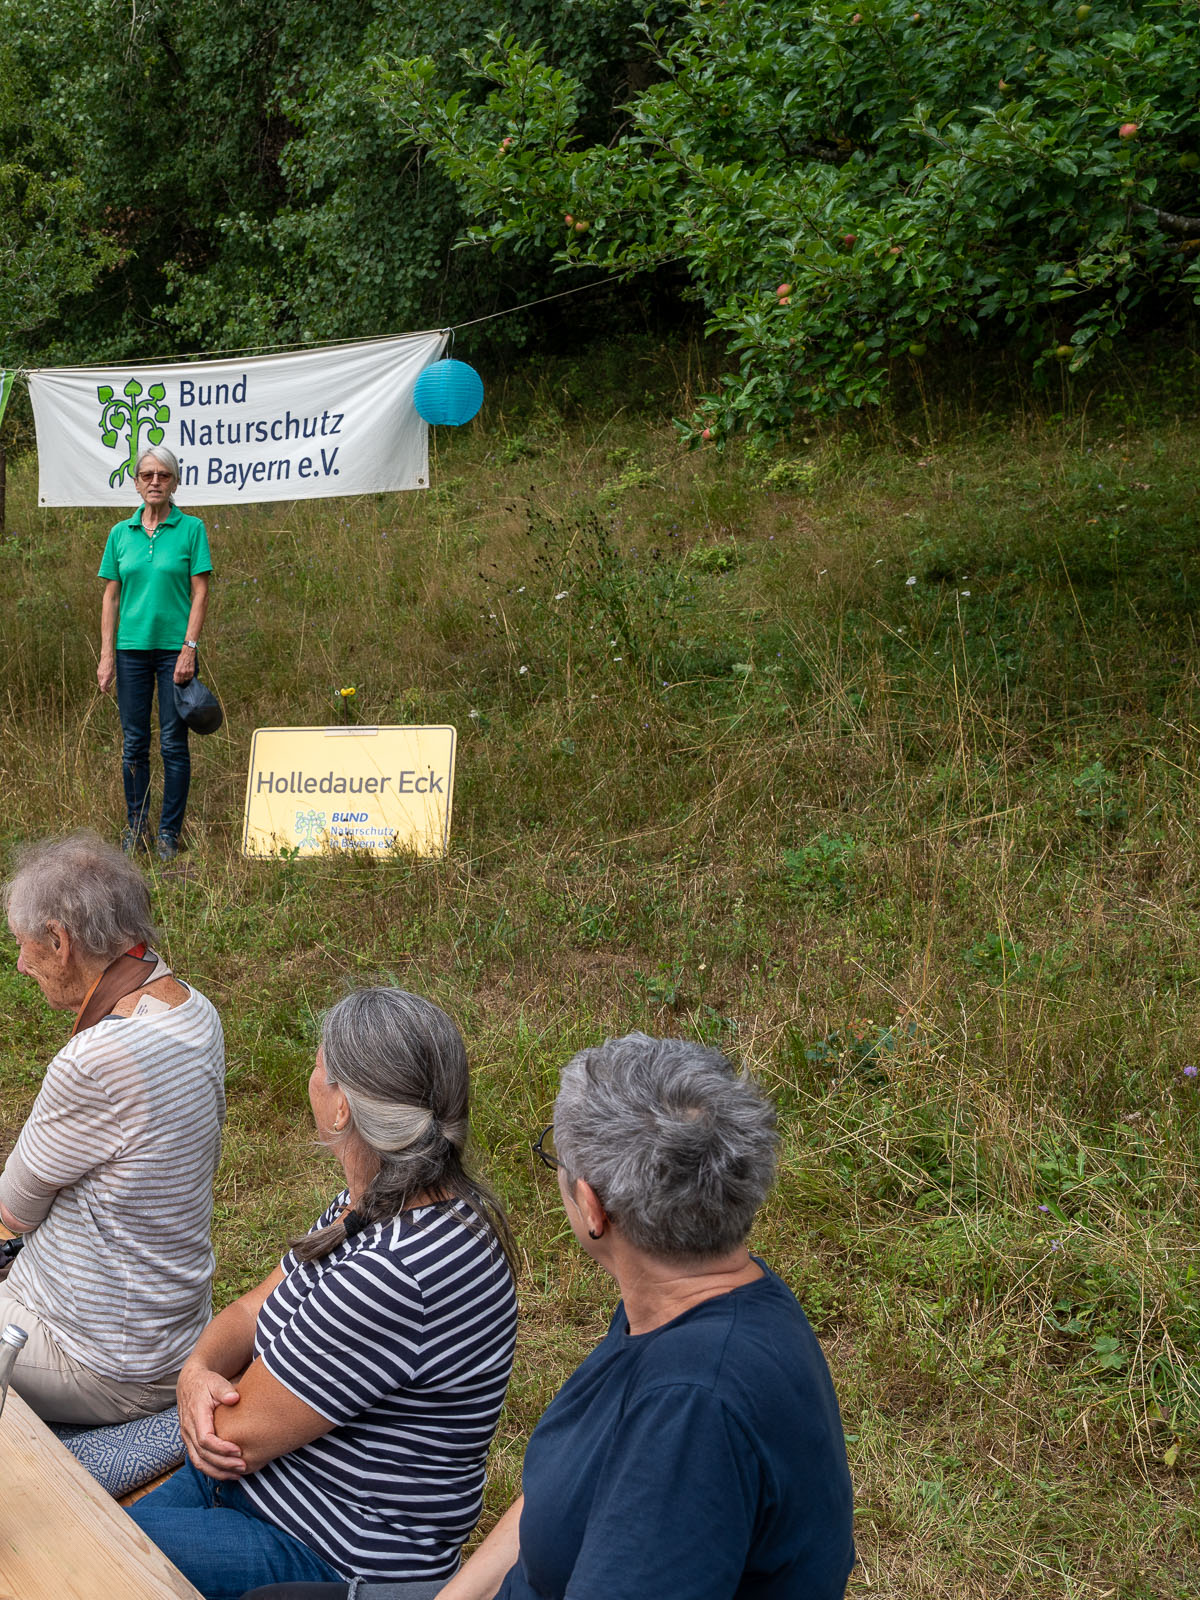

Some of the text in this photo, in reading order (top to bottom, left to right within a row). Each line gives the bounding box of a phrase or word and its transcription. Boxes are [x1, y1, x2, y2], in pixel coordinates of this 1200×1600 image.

[180, 374, 247, 407] Bund
[180, 410, 344, 446] Naturschutz
[179, 447, 340, 491] in Bayern e.V.
[256, 770, 444, 793] Holledauer Eck
[330, 826, 394, 836] Naturschutz
[331, 812, 369, 823] BUND
